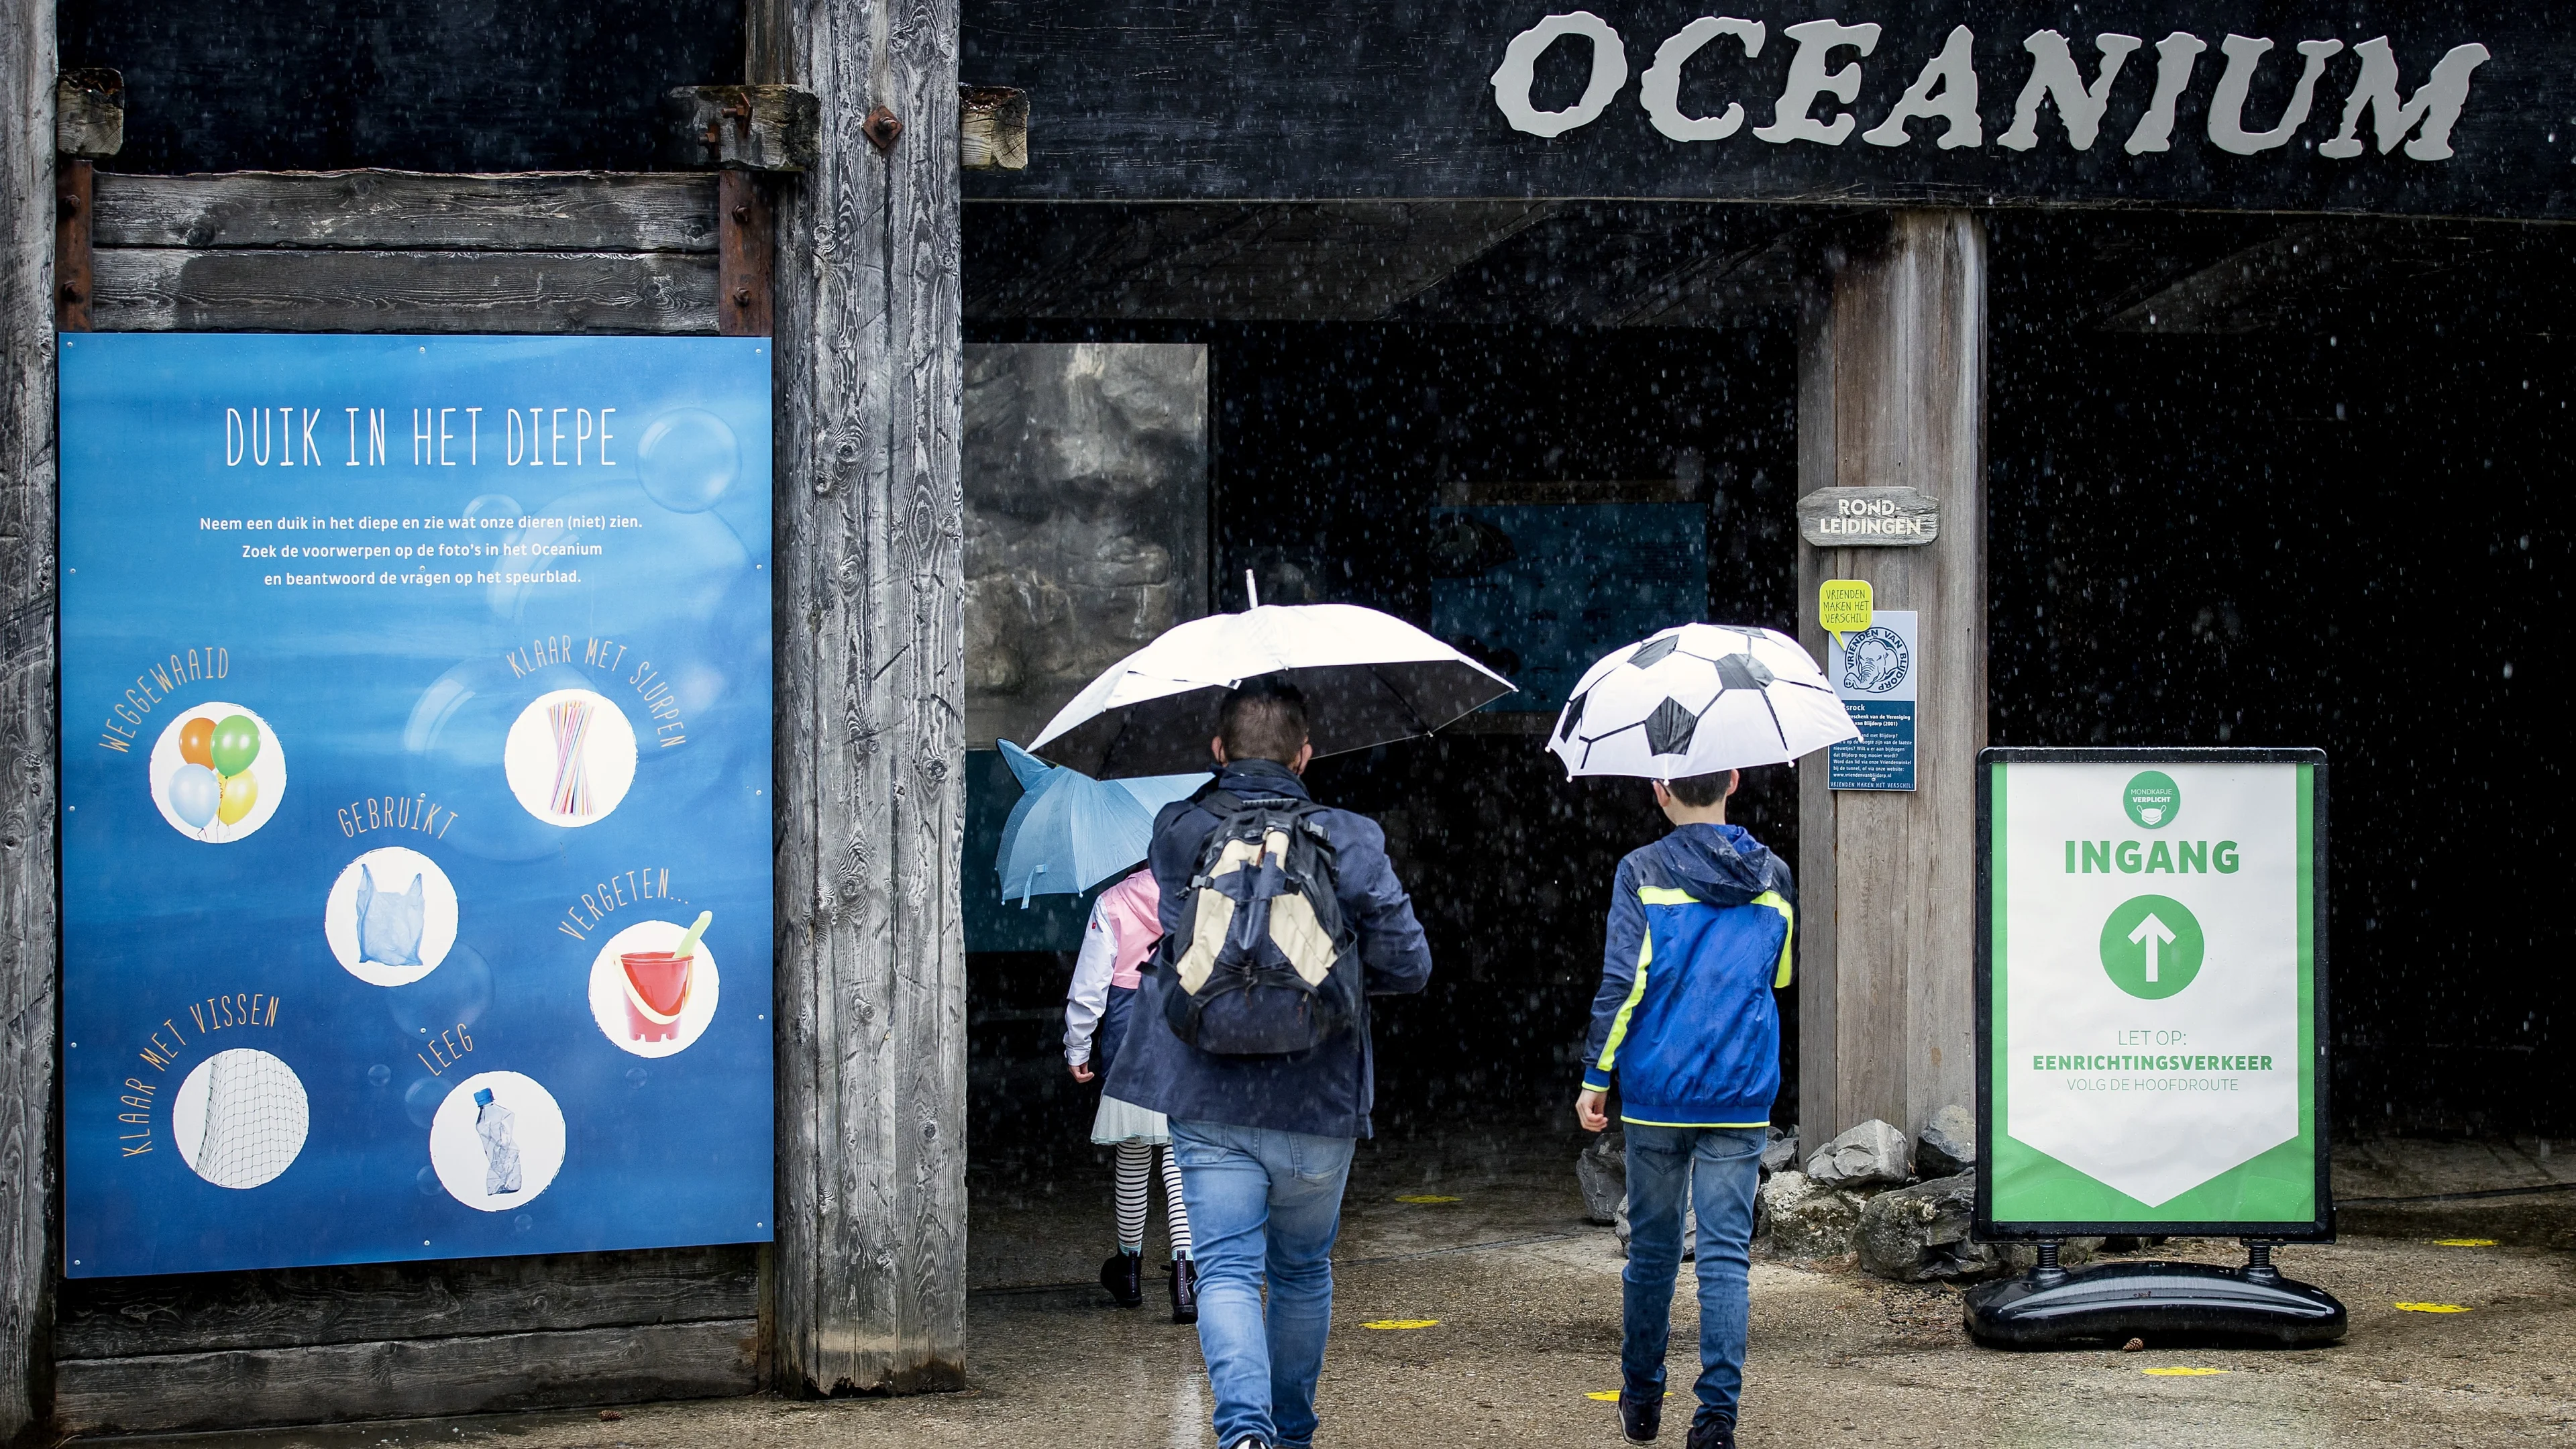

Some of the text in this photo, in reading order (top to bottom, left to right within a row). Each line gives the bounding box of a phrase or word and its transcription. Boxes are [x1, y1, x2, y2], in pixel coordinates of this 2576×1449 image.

[1490, 9, 2491, 162] OCEANIUM
[227, 408, 616, 466] DUIK IN HET DIEPE
[1839, 499, 1901, 515] ROND-
[201, 515, 642, 531] Neem een duik in het diepe en zie wat onze dieren (niet) zien.
[1820, 519, 1921, 535] LEIDINGEN
[243, 543, 601, 559] Zoek de voorwerpen op de foto's in het Oceanium
[265, 570, 580, 586] en beantwoord de vragen op het speurblad.
[1826, 590, 1865, 600] VRIENDEN
[1823, 601, 1869, 611] MAKEN HET
[1825, 613, 1868, 623] VERSCHIL!
[1847, 629, 1907, 690] VRIENDEN VAN BLIJDORP
[506, 635, 686, 747] KLAAR MET SLURPEN
[99, 647, 229, 753] WEGGEWAAID
[338, 796, 458, 839] GEBRUIKT
[2065, 841, 2239, 873] INGANG
[2118, 1030, 2186, 1045] LET OP:
[418, 1023, 473, 1076] LEEG
[2033, 1055, 2273, 1071] EENRICHTINGSVERKEER
[119, 994, 279, 1157] KLAAR MET VISSEN
[2067, 1079, 2238, 1091] VOLG DE HOOFDROUTE
